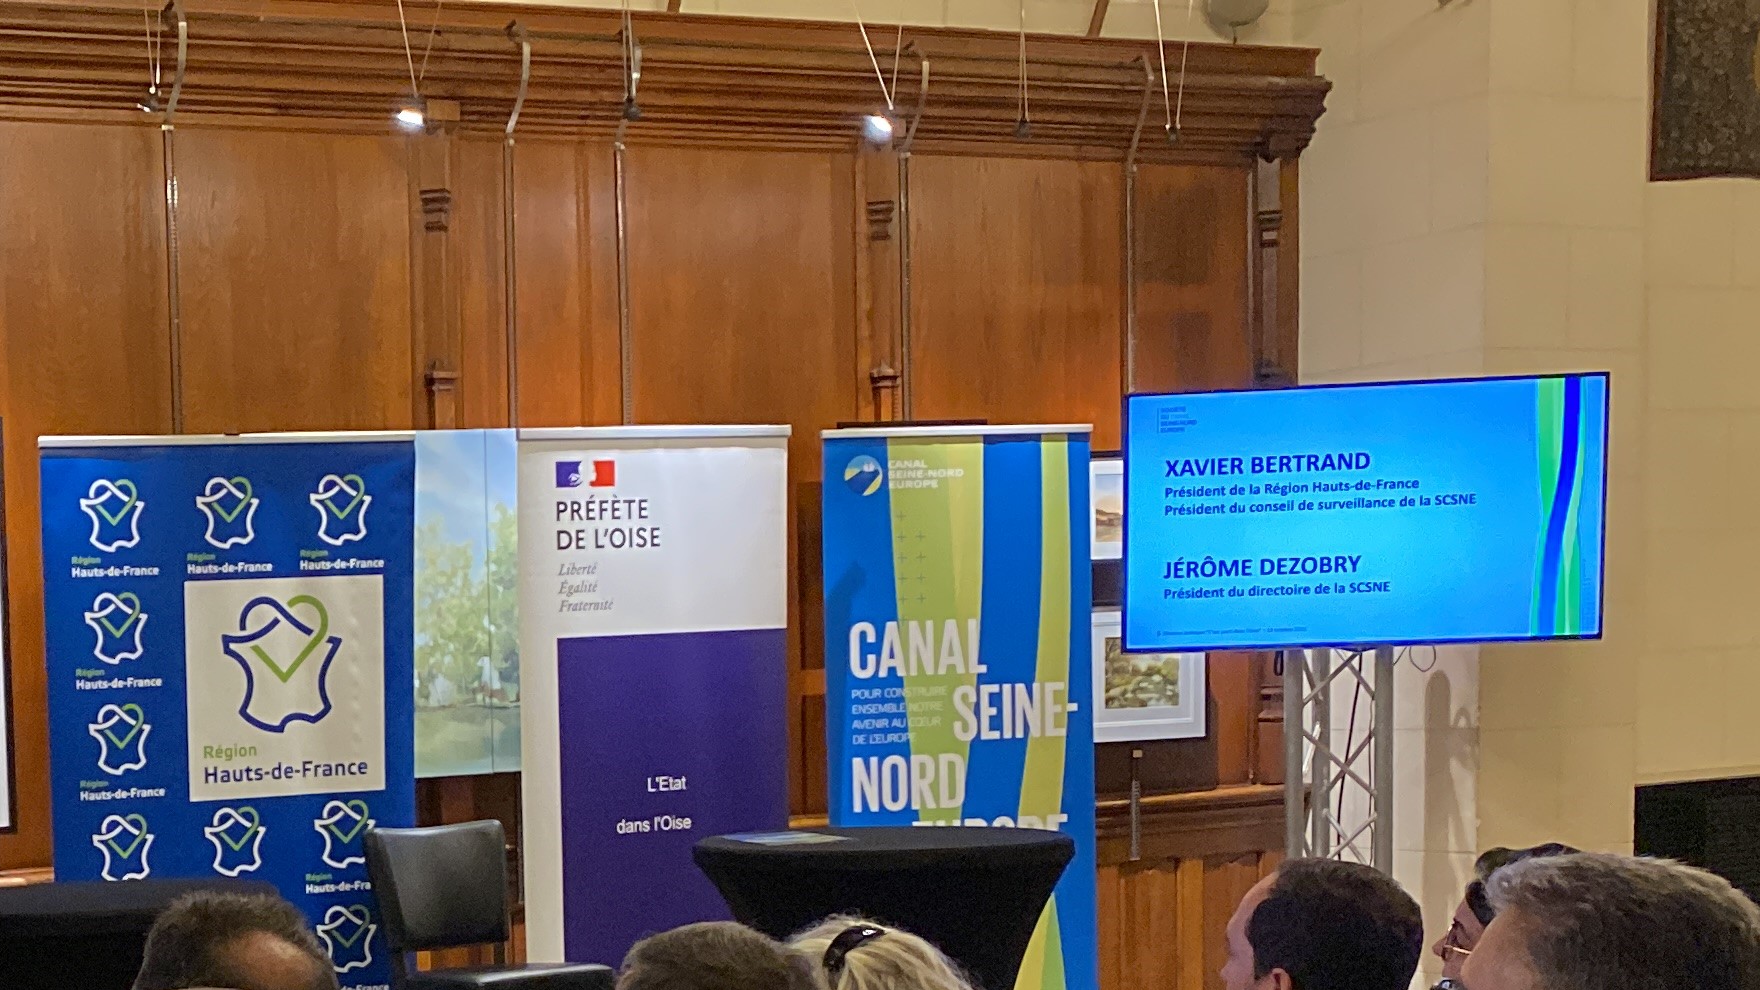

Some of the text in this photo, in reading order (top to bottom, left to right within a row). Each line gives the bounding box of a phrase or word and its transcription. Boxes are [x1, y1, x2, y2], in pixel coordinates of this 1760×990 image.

[1165, 452, 1371, 477] XAVIER BERTRAND
[1165, 479, 1419, 499] Président de la Région Hauts-de-France
[556, 494, 648, 521] PRÉFÈTE
[1165, 493, 1476, 516] Président du conseil de surveillance de la SCSNE
[557, 527, 661, 550] DE L'OISE
[71, 566, 159, 578] Hauts-de-France
[187, 561, 273, 573] Hauts-de-France
[299, 558, 384, 570] Hauts-de-France
[558, 561, 598, 576] Liberté
[1163, 555, 1361, 579] JÉRÔME DEZOBRY
[558, 580, 598, 597] Égalité
[1164, 581, 1390, 600] Président du directoire de la SCSNE
[559, 598, 614, 612] Fraternité
[849, 618, 988, 679] CANAL
[76, 677, 162, 690] Hauts-de-France
[851, 688, 881, 699] POUR
[852, 702, 907, 714] ENSEMBLE
[953, 682, 1078, 742] SEINE-
[891, 718, 906, 728] AU
[852, 734, 866, 745] DE
[203, 744, 257, 761] Région
[204, 760, 368, 784] Hauts-de-France
[647, 775, 687, 793] L'Etat
[851, 753, 966, 813] NORD
[80, 787, 165, 800] Hauts-de-France
[617, 815, 692, 834] dans l'Oise
[306, 880, 371, 894] Hauts-de-Fra
